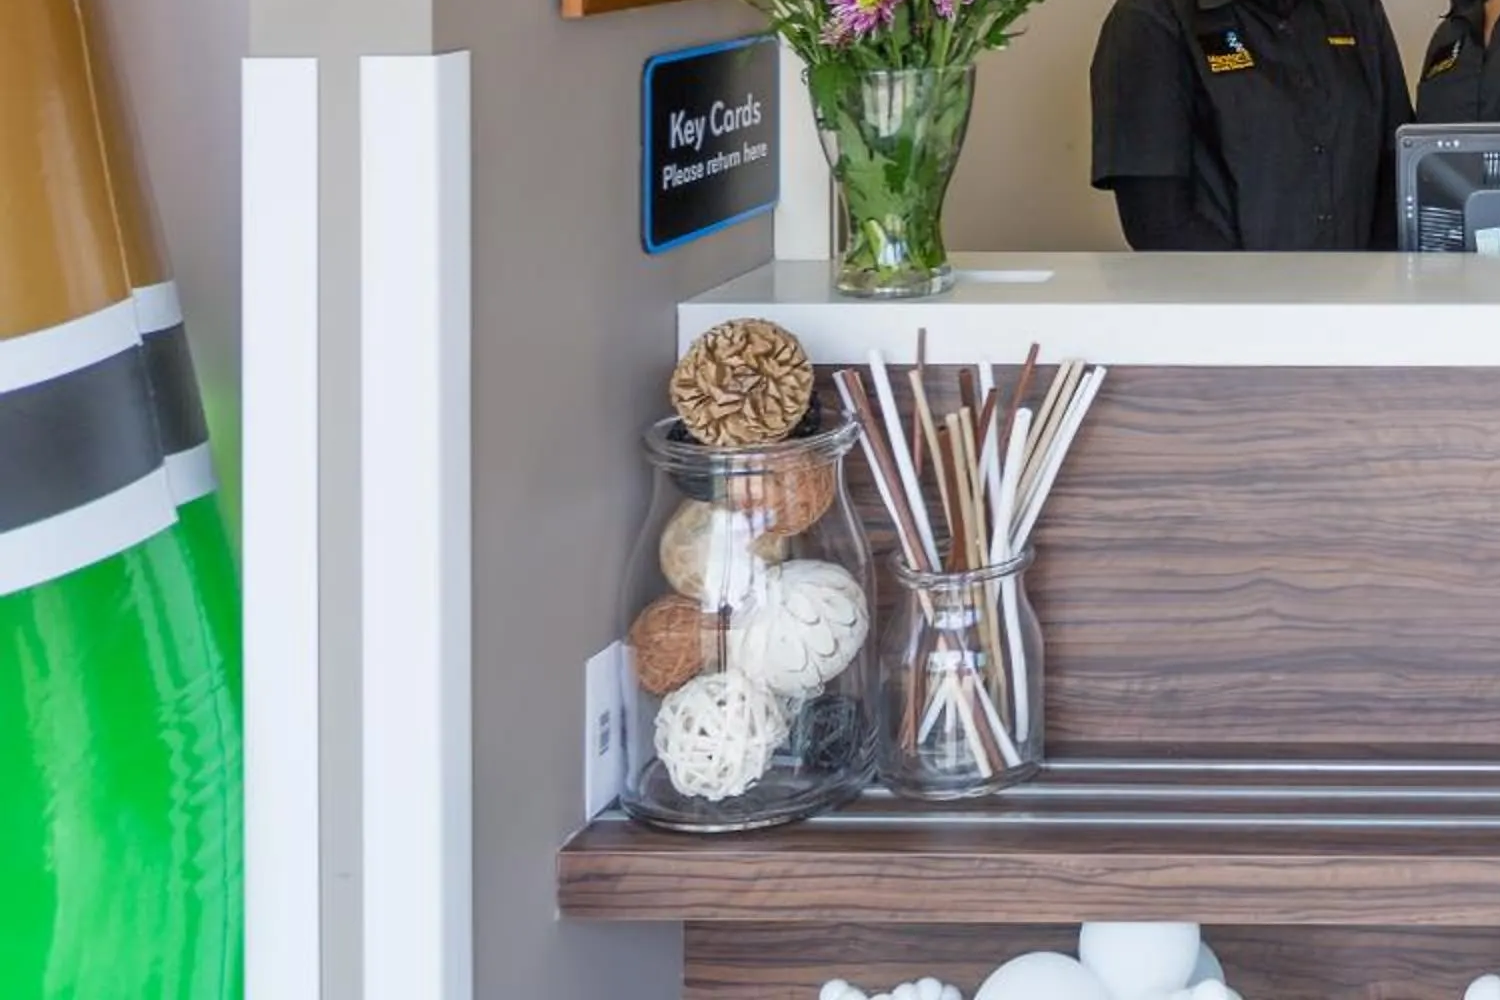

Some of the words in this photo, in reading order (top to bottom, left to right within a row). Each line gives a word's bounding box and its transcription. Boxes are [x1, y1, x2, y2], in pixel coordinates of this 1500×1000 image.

[669, 109, 706, 151] Key
[709, 93, 762, 137] Cards
[662, 162, 704, 190] Please
[706, 150, 742, 175] return
[743, 141, 768, 163] here
